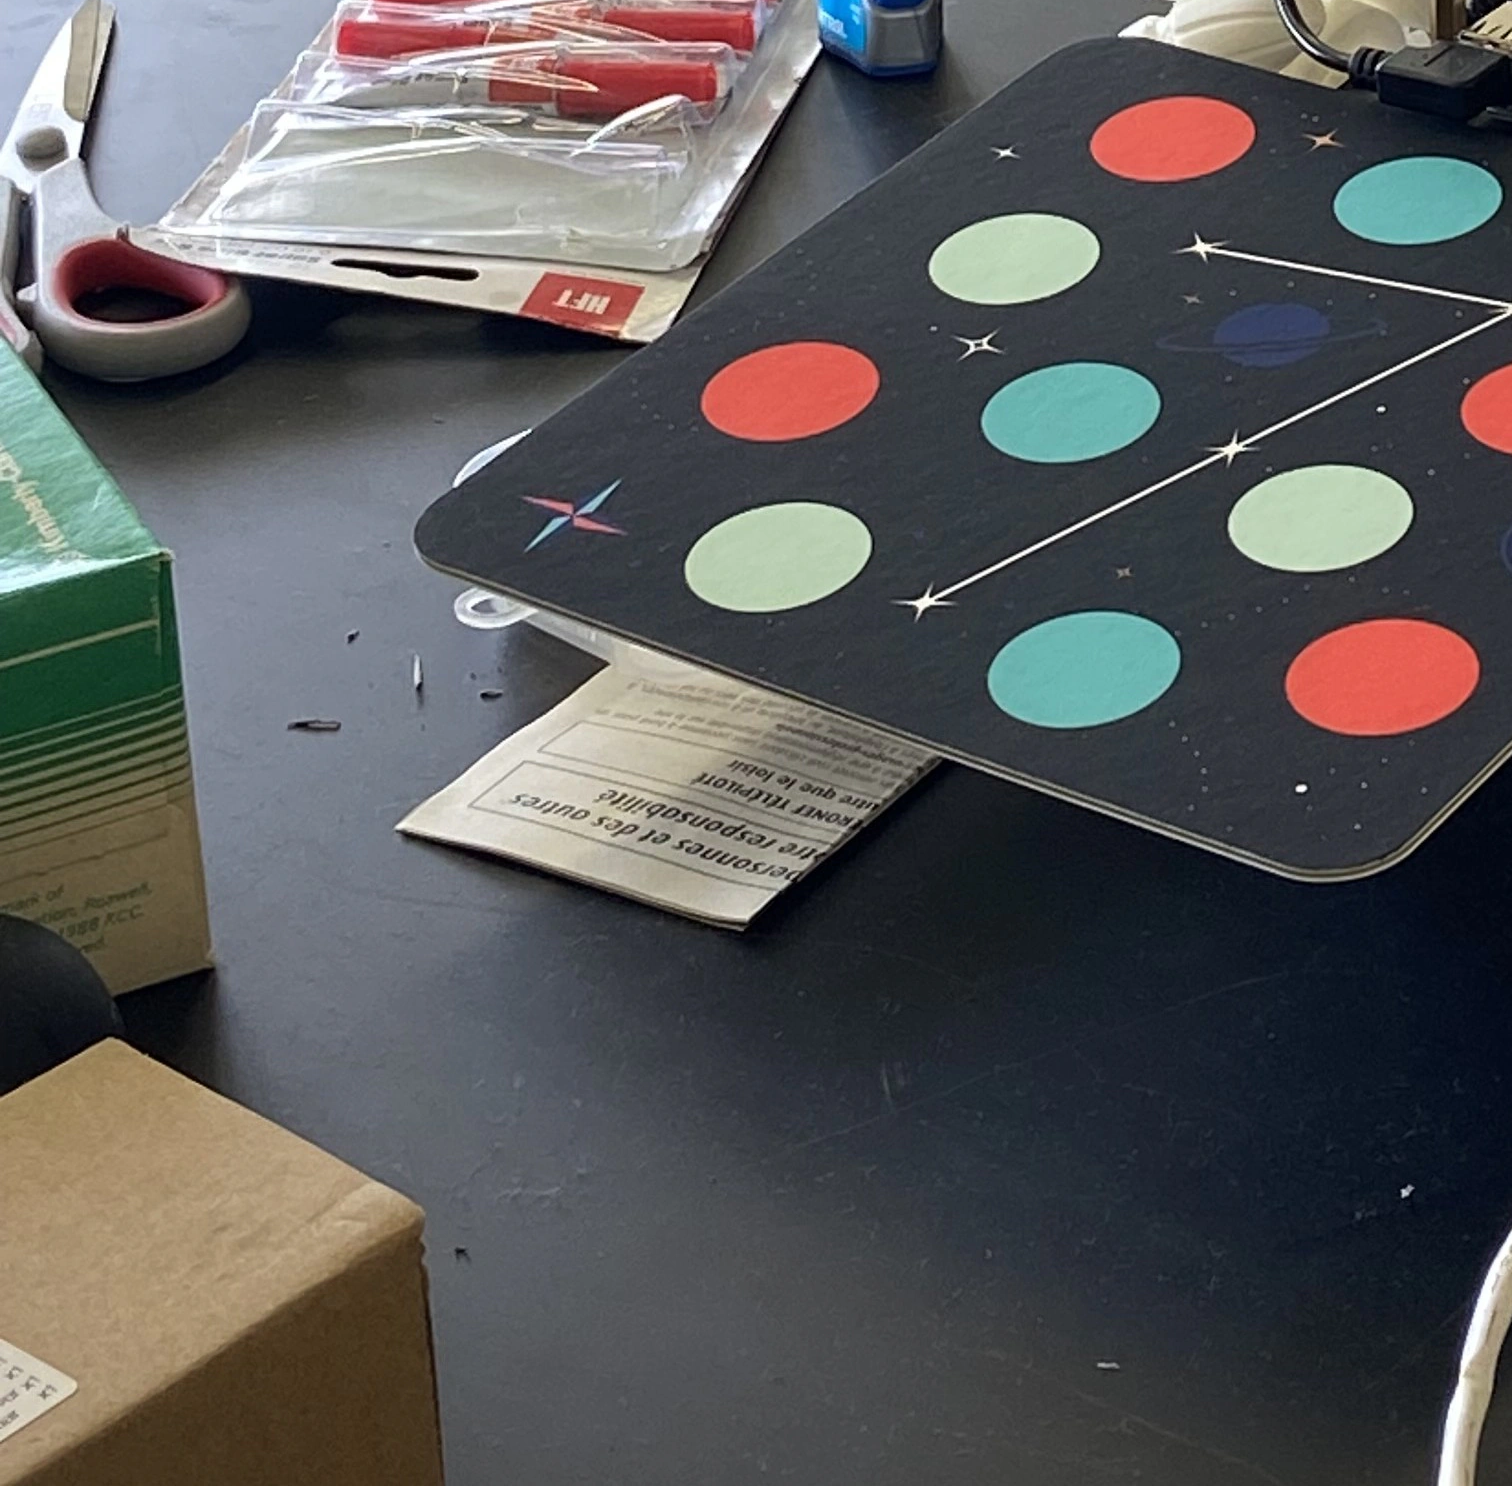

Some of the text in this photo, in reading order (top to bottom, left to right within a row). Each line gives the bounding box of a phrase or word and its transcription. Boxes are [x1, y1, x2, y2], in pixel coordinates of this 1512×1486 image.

[552, 289, 611, 314] HFT
[728, 759, 775, 783] loisir
[776, 774, 798, 791] le
[799, 782, 837, 801] que
[510, 793, 591, 820] autres
[590, 815, 641, 838] des
[592, 789, 777, 850] responsabilité
[637, 829, 671, 845] et
